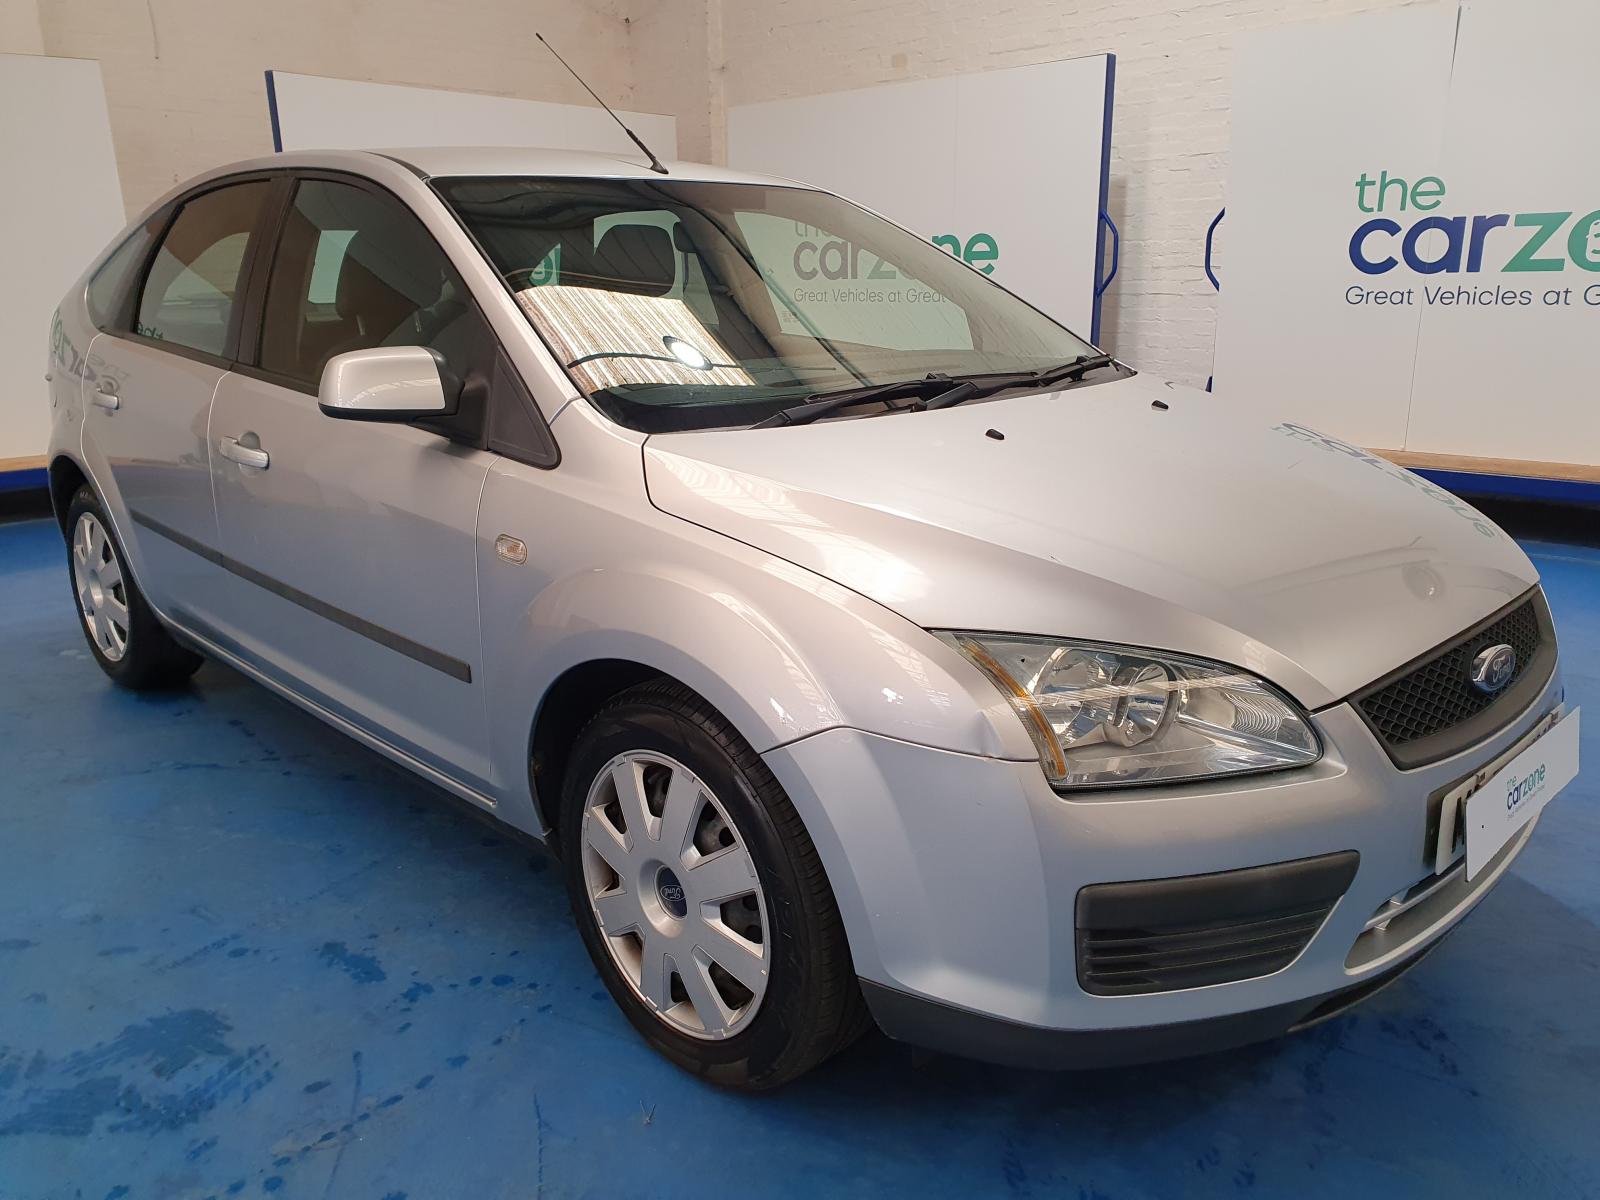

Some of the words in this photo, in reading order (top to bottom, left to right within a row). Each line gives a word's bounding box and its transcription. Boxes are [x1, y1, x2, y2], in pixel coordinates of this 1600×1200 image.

[1355, 170, 1446, 213] the
[793, 287, 828, 304] Great
[832, 287, 884, 304] Vehicles
[887, 290, 903, 304] at
[1345, 285, 1414, 306] Great
[1424, 285, 1532, 306] Vehicles
[1542, 287, 1573, 306] at
[1506, 762, 1546, 811] carzone
